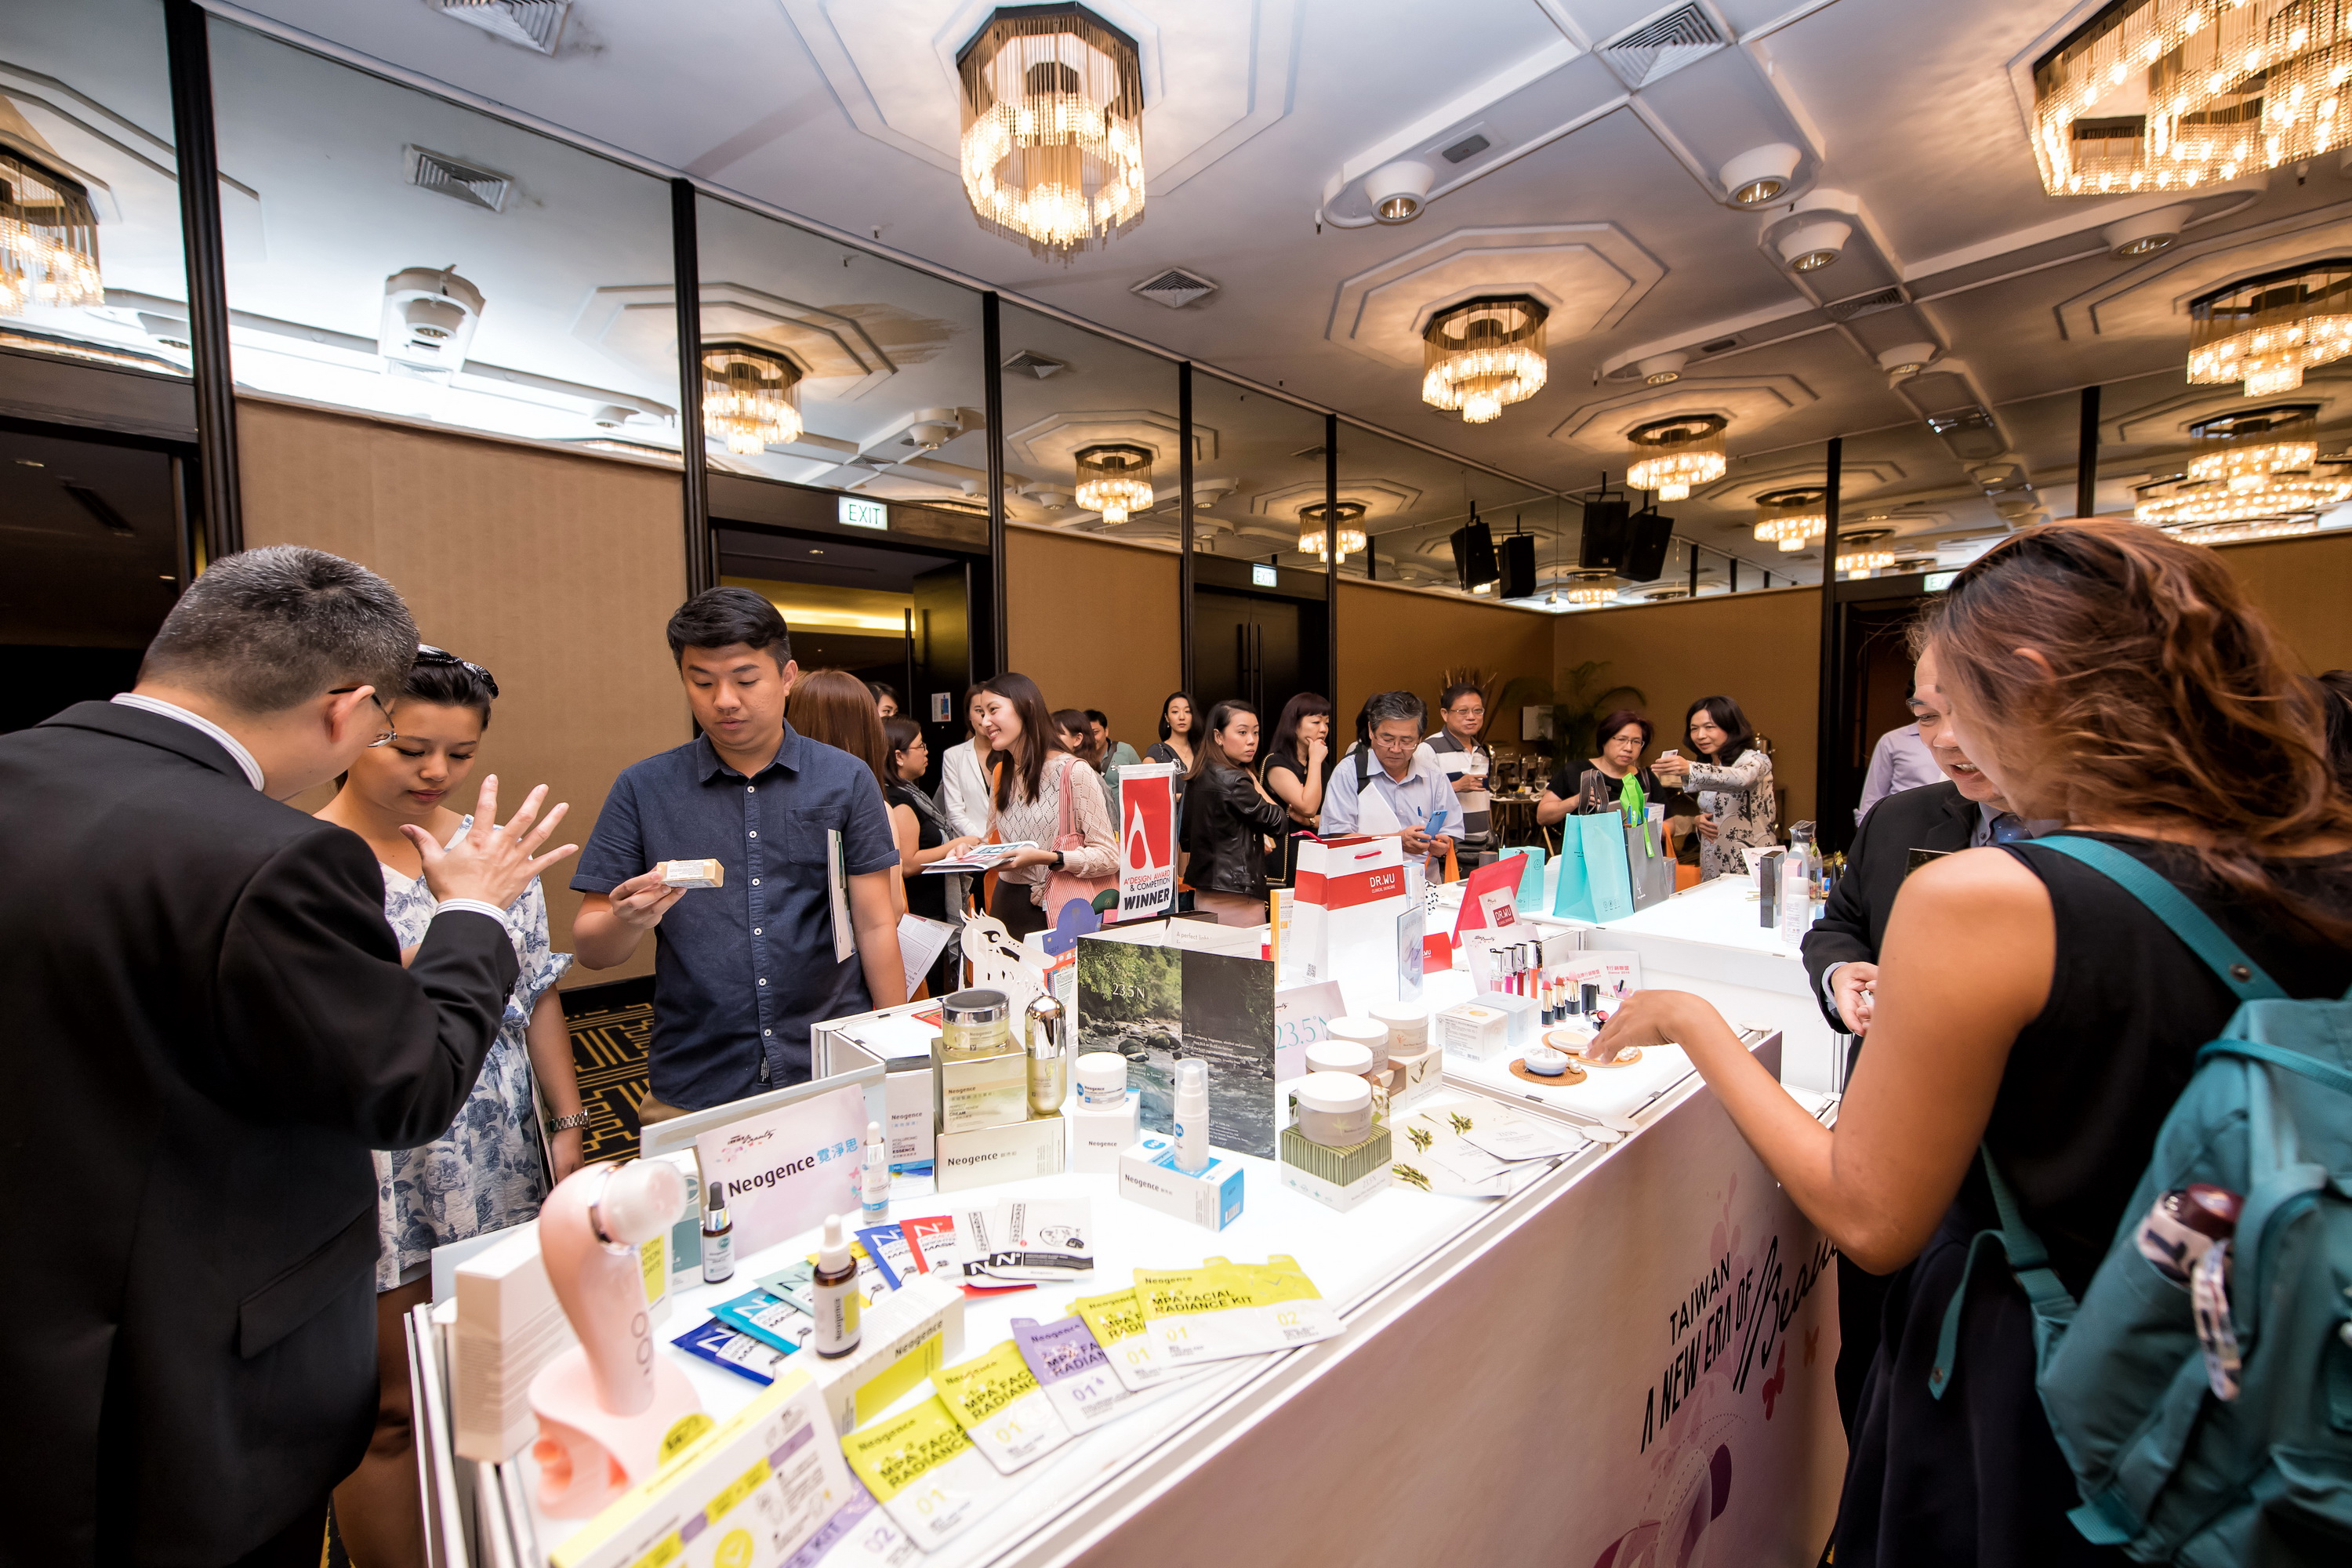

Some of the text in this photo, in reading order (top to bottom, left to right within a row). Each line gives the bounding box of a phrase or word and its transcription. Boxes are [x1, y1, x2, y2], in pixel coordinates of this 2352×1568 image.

[849, 504, 880, 524] EXIT
[1256, 570, 1272, 584] EXIT
[1137, 877, 1171, 891] COMPETITION
[1153, 869, 1171, 880] AWARD
[1369, 873, 1396, 887] DR.WU
[1124, 887, 1170, 911] WINNER
[1494, 907, 1512, 921] DR.WU
[1181, 932, 1198, 941] perfect
[947, 1151, 998, 1167] Neogence
[728, 1156, 815, 1198] Neogence
[1125, 1174, 1160, 1192] Neogence
[1145, 1276, 1192, 1285] Neogence
[1152, 1290, 1235, 1306] MPA FACIAL
[1155, 1295, 1254, 1314] RADIANCE KIT
[1669, 1251, 1730, 1346] TAIWAN
[1277, 1309, 1301, 1326] 02
[895, 1319, 943, 1359] Neogence
[1031, 1323, 1080, 1344] Neogence
[1166, 1326, 1188, 1342] 01
[1127, 1346, 1150, 1366] 01
[1659, 1329, 1702, 1431] NEW
[1704, 1293, 1731, 1374] ERA
[1735, 1266, 1753, 1332] OF
[946, 1360, 998, 1387] Neogence
[1053, 1350, 1107, 1377] RADIAN
[964, 1387, 997, 1411] MPA
[972, 1377, 1039, 1420] RADIANC
[1072, 1384, 1097, 1402] 01
[858, 1417, 917, 1453] Neogence
[996, 1420, 1024, 1444] 01
[879, 1423, 964, 1479] MPA FACIA
[916, 1488, 947, 1515] 01
